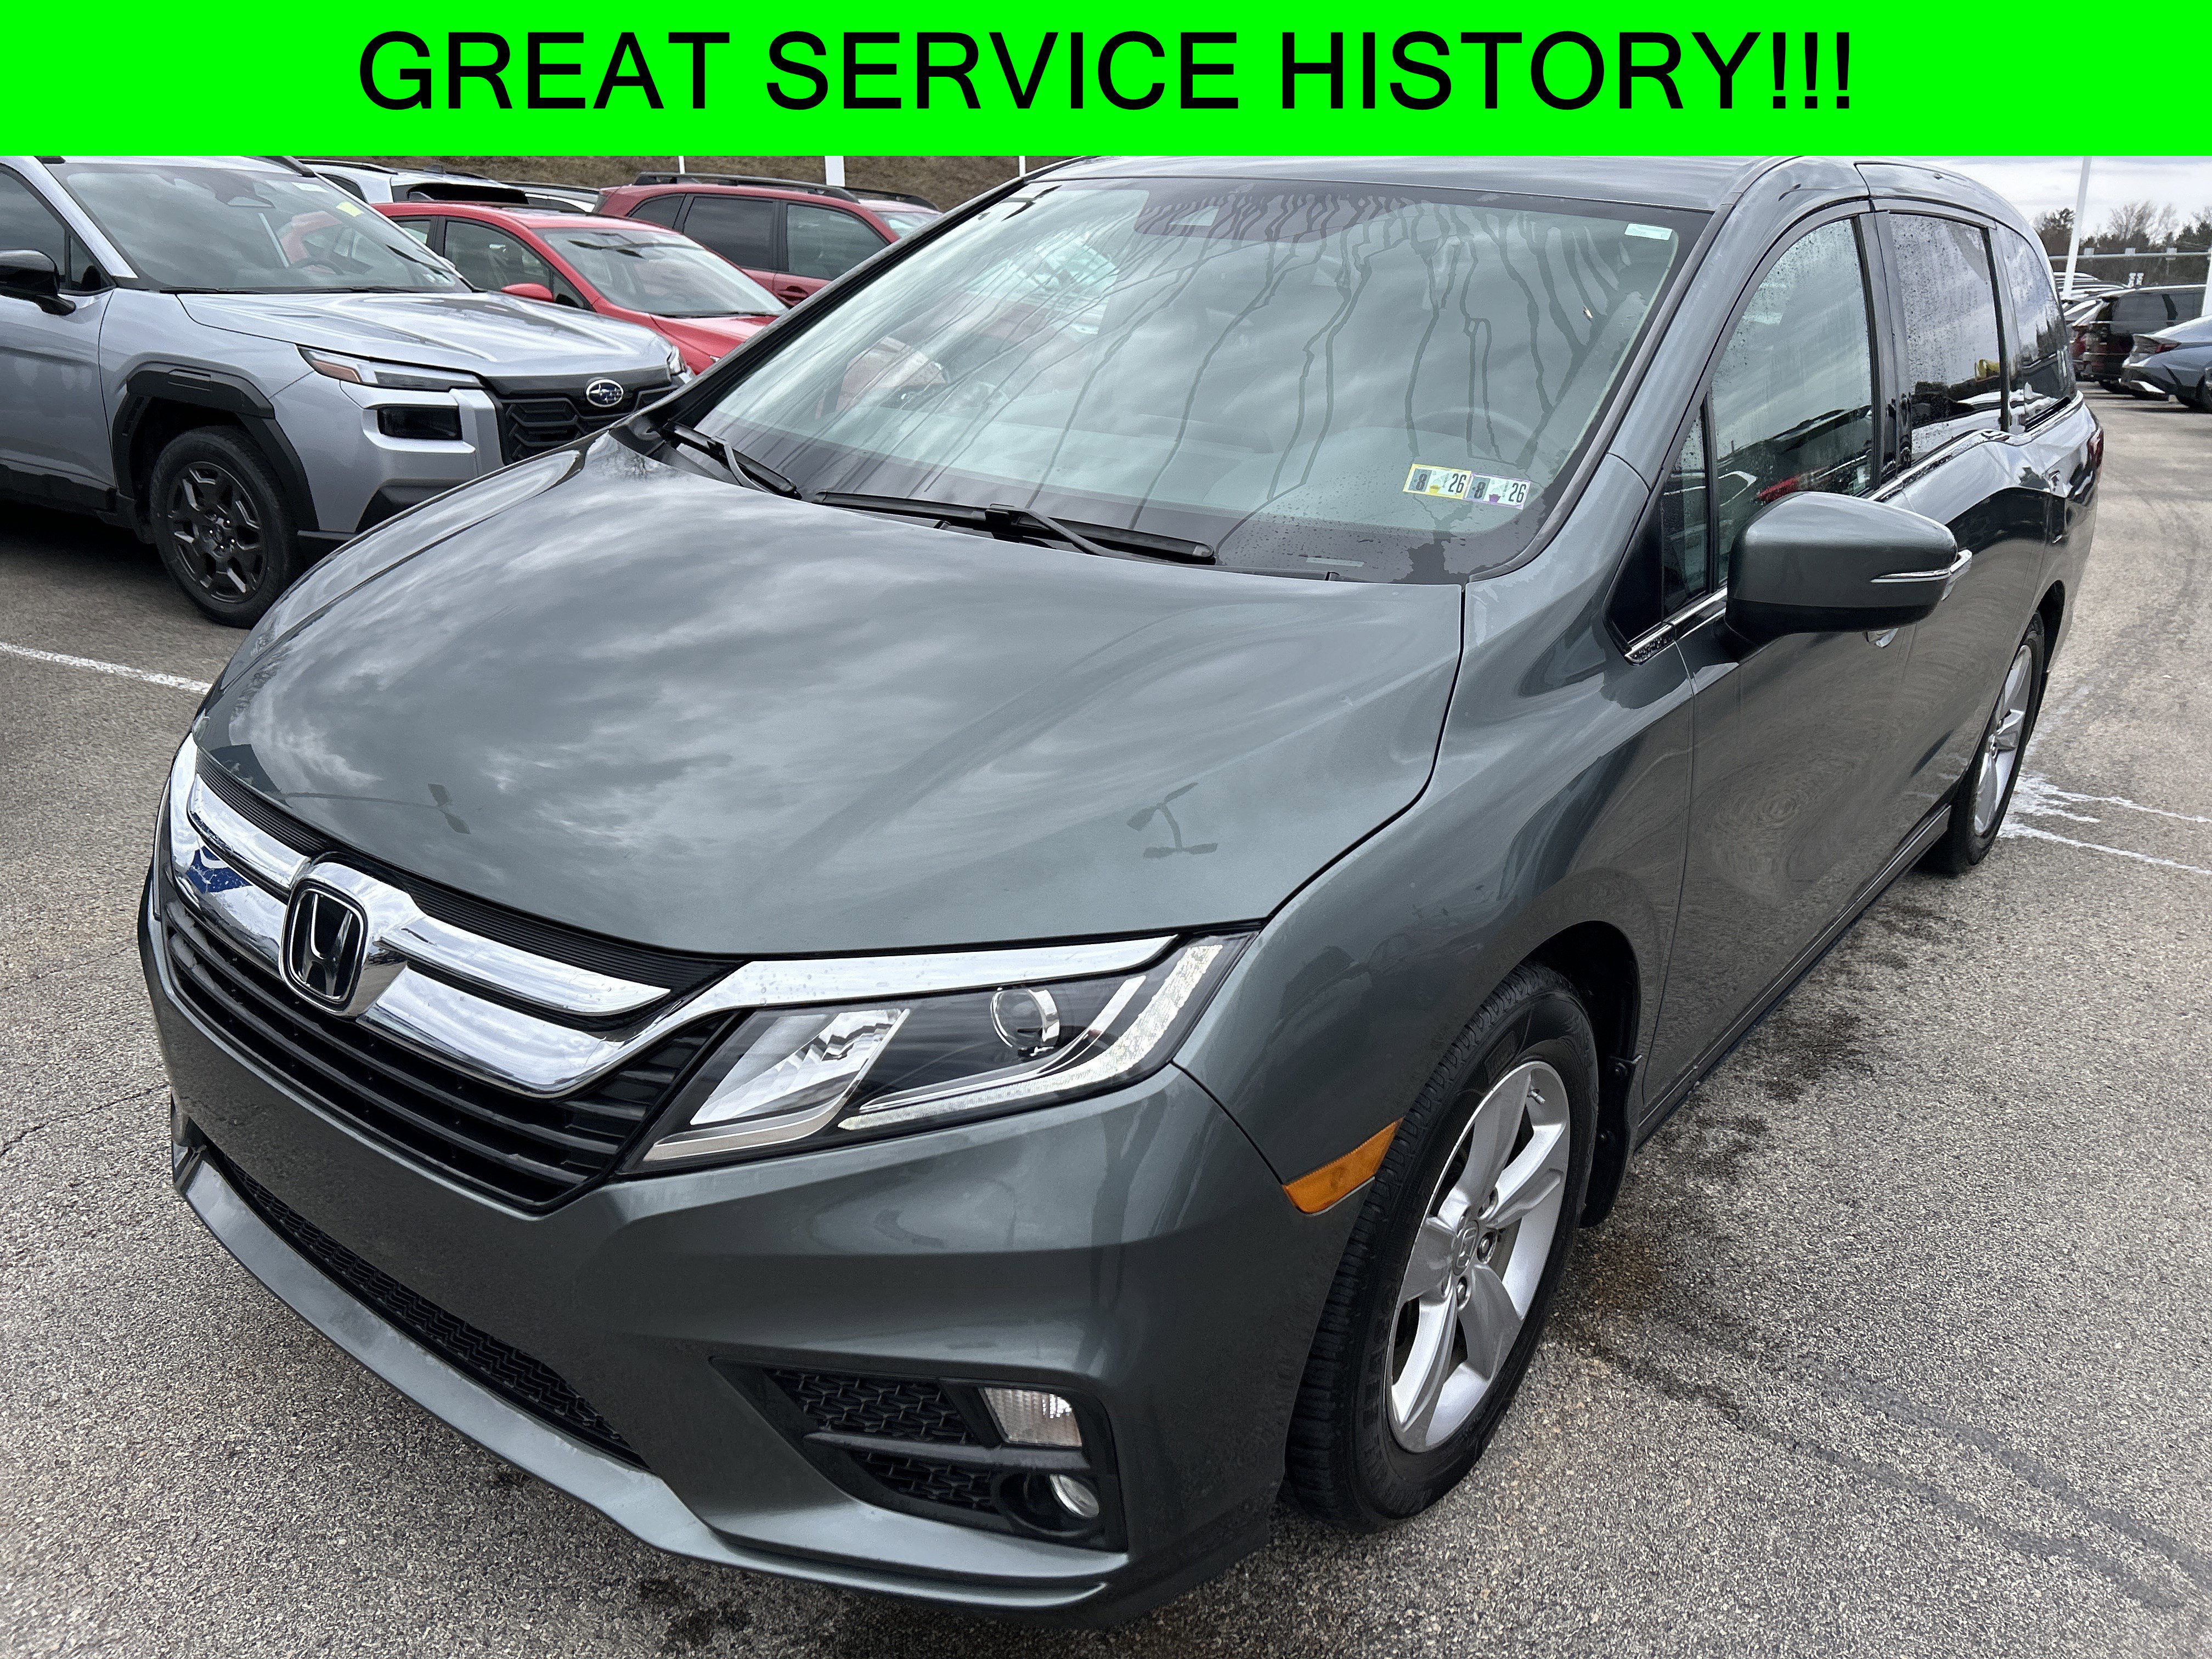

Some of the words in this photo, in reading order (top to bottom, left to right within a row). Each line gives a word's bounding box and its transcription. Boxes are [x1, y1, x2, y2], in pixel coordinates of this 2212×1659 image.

[1415, 473, 1428, 491] 8
[1448, 473, 1467, 494] 26
[1474, 481, 1486, 499] 8
[1508, 482, 1527, 504] 26
